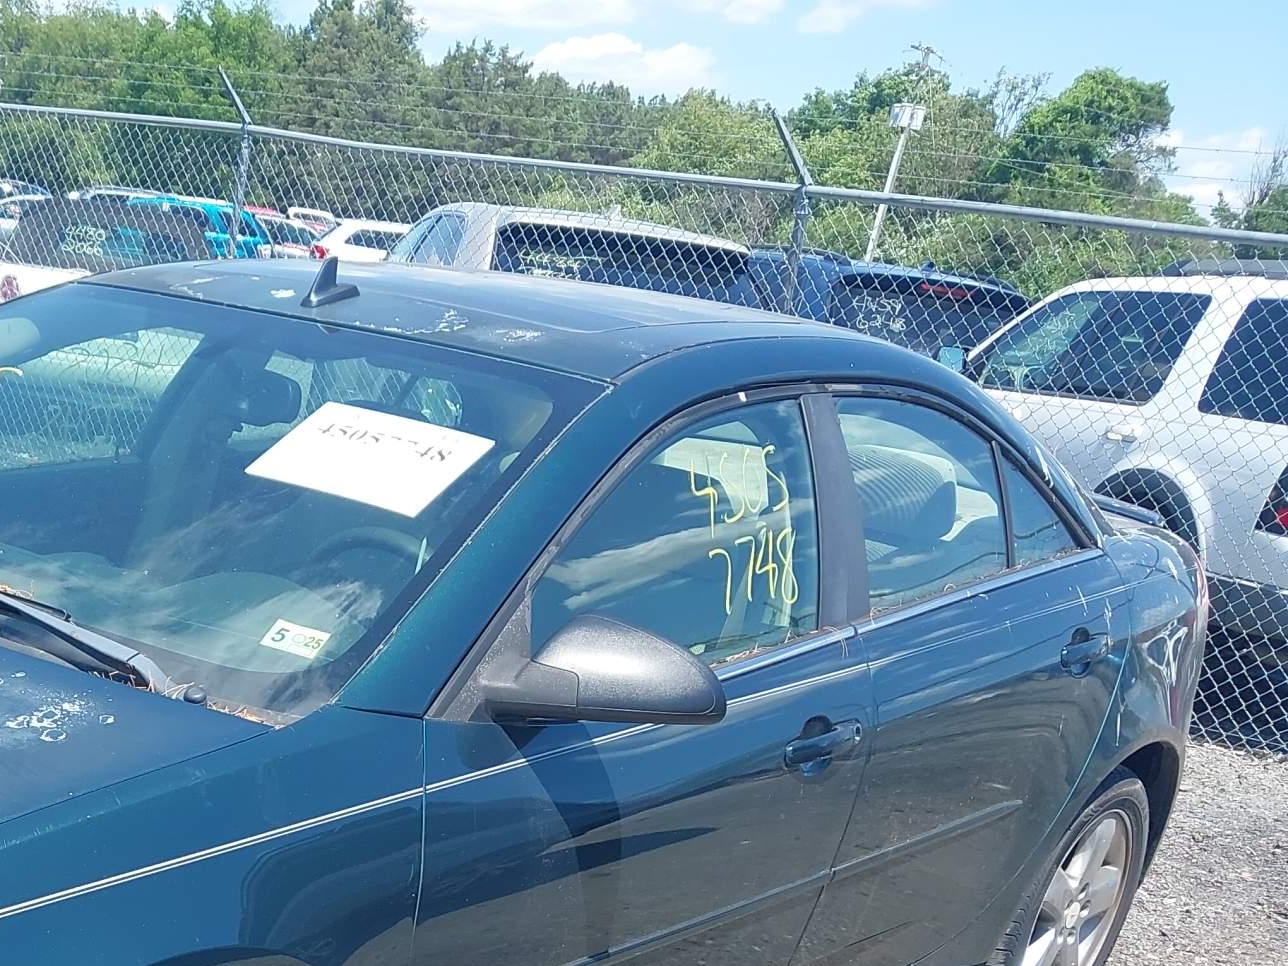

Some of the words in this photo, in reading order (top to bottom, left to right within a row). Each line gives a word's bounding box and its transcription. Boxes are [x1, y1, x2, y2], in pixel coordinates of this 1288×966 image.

[66, 225, 105, 241] 4480
[689, 445, 790, 539] 4505
[708, 525, 799, 616] 7748
[271, 627, 291, 642] 5
[303, 636, 324, 650] 25
